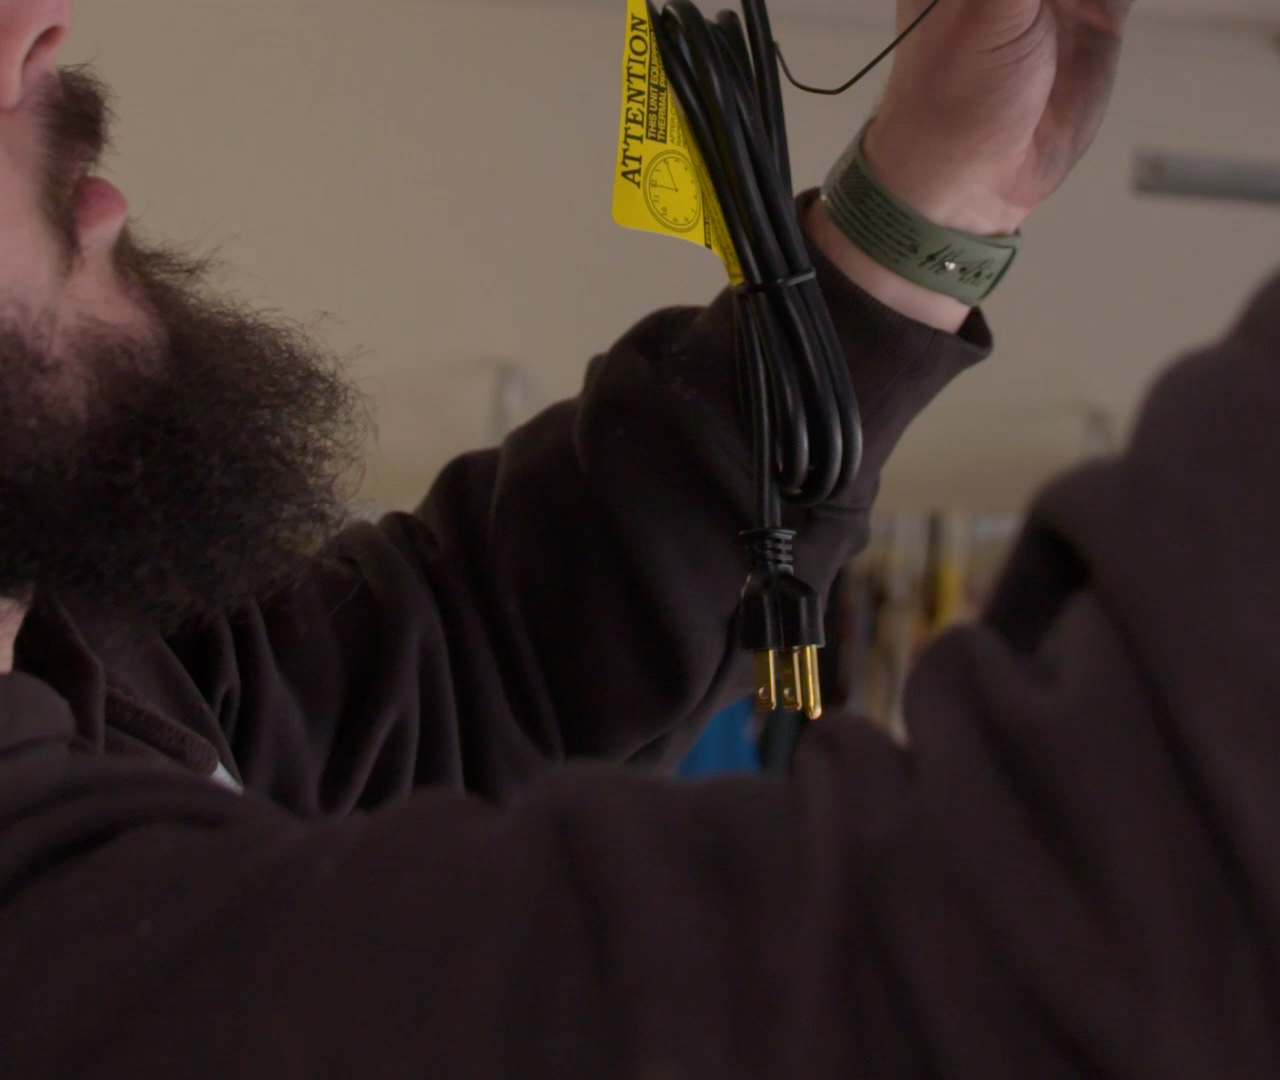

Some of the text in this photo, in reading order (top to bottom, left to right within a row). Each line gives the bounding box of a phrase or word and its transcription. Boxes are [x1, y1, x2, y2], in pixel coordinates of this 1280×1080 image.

[620, 13, 648, 190] ATTENTION
[649, 86, 658, 111] UNIT
[657, 91, 667, 140] THERMAL
[648, 113, 657, 138] THIS
